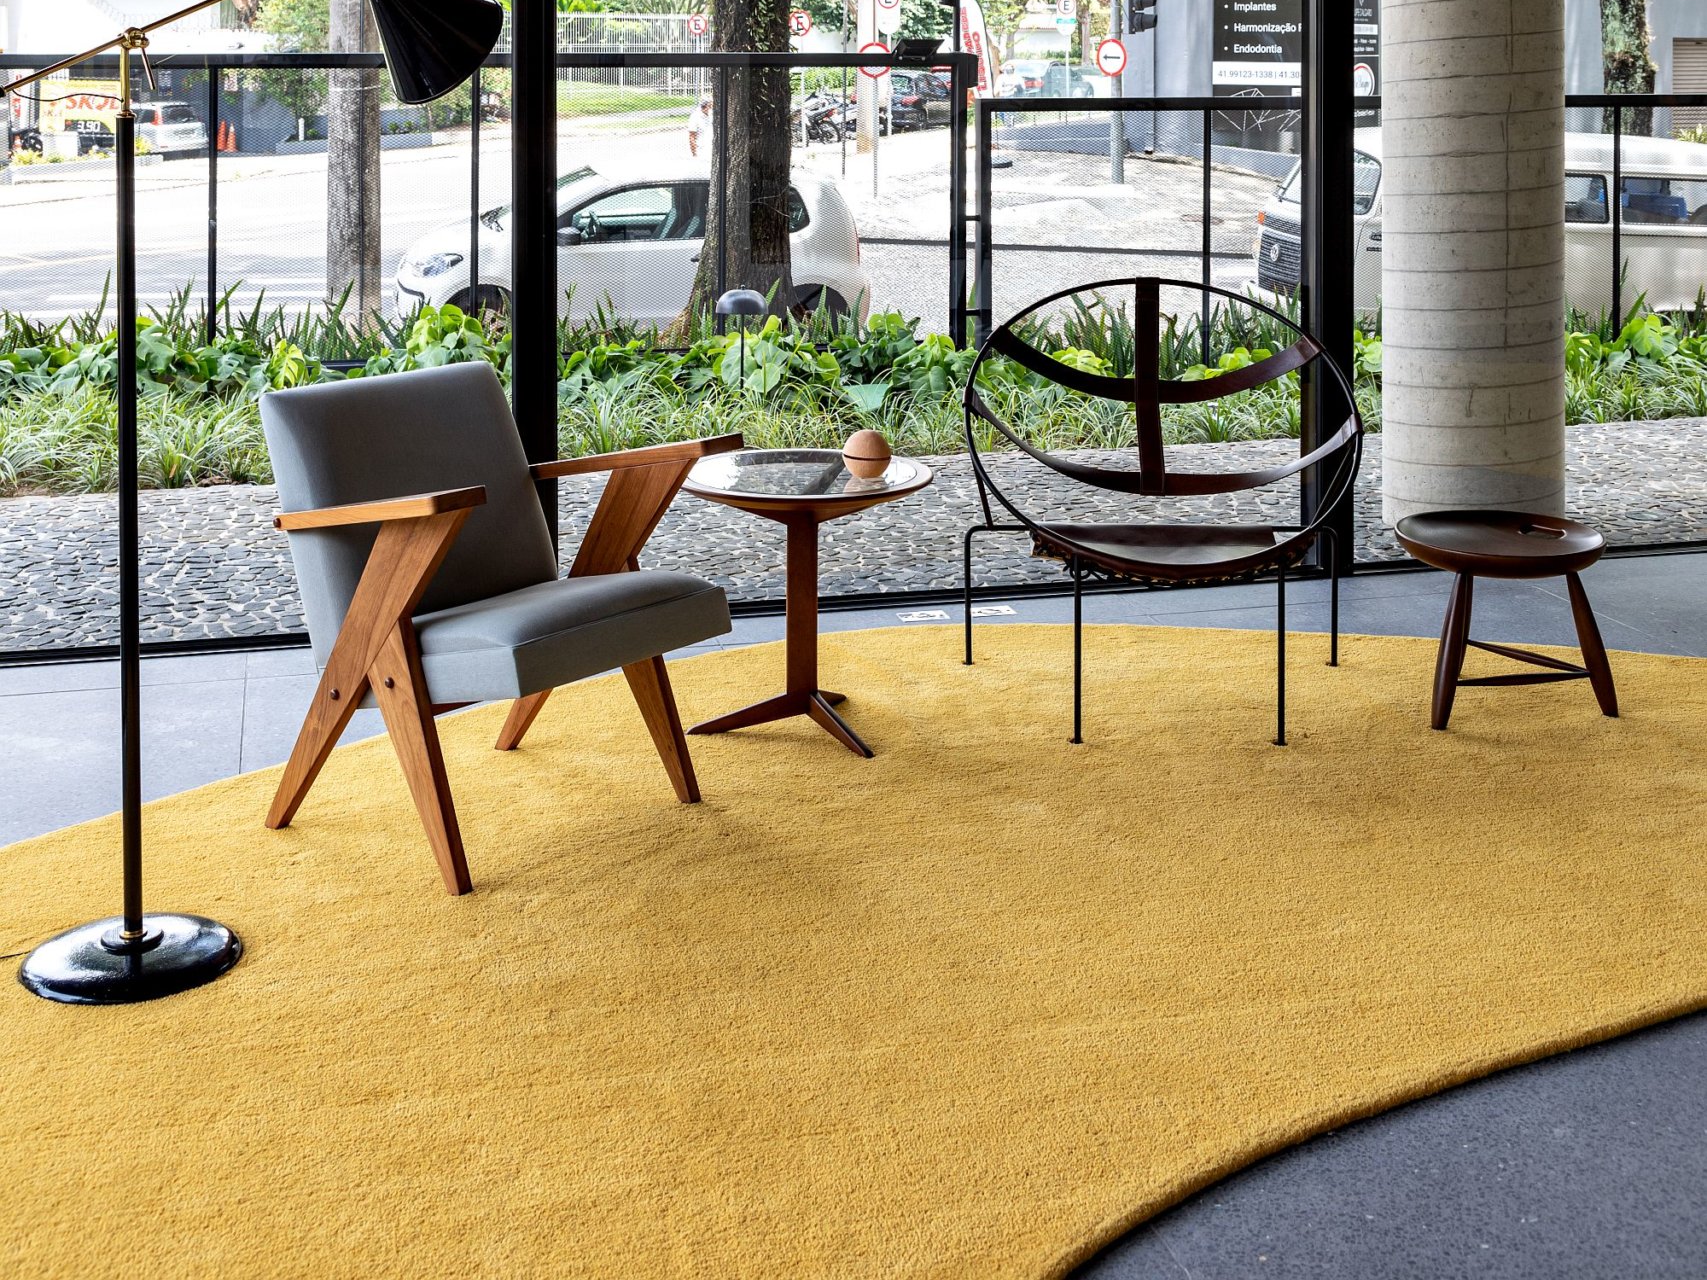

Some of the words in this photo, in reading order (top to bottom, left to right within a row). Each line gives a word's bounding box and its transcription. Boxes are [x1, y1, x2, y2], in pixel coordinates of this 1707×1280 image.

[1063, 0, 1070, 10] E
[1234, 1, 1277, 13] Implantes
[1233, 22, 1297, 34] Harmonização
[1233, 44, 1282, 54] Endodontia
